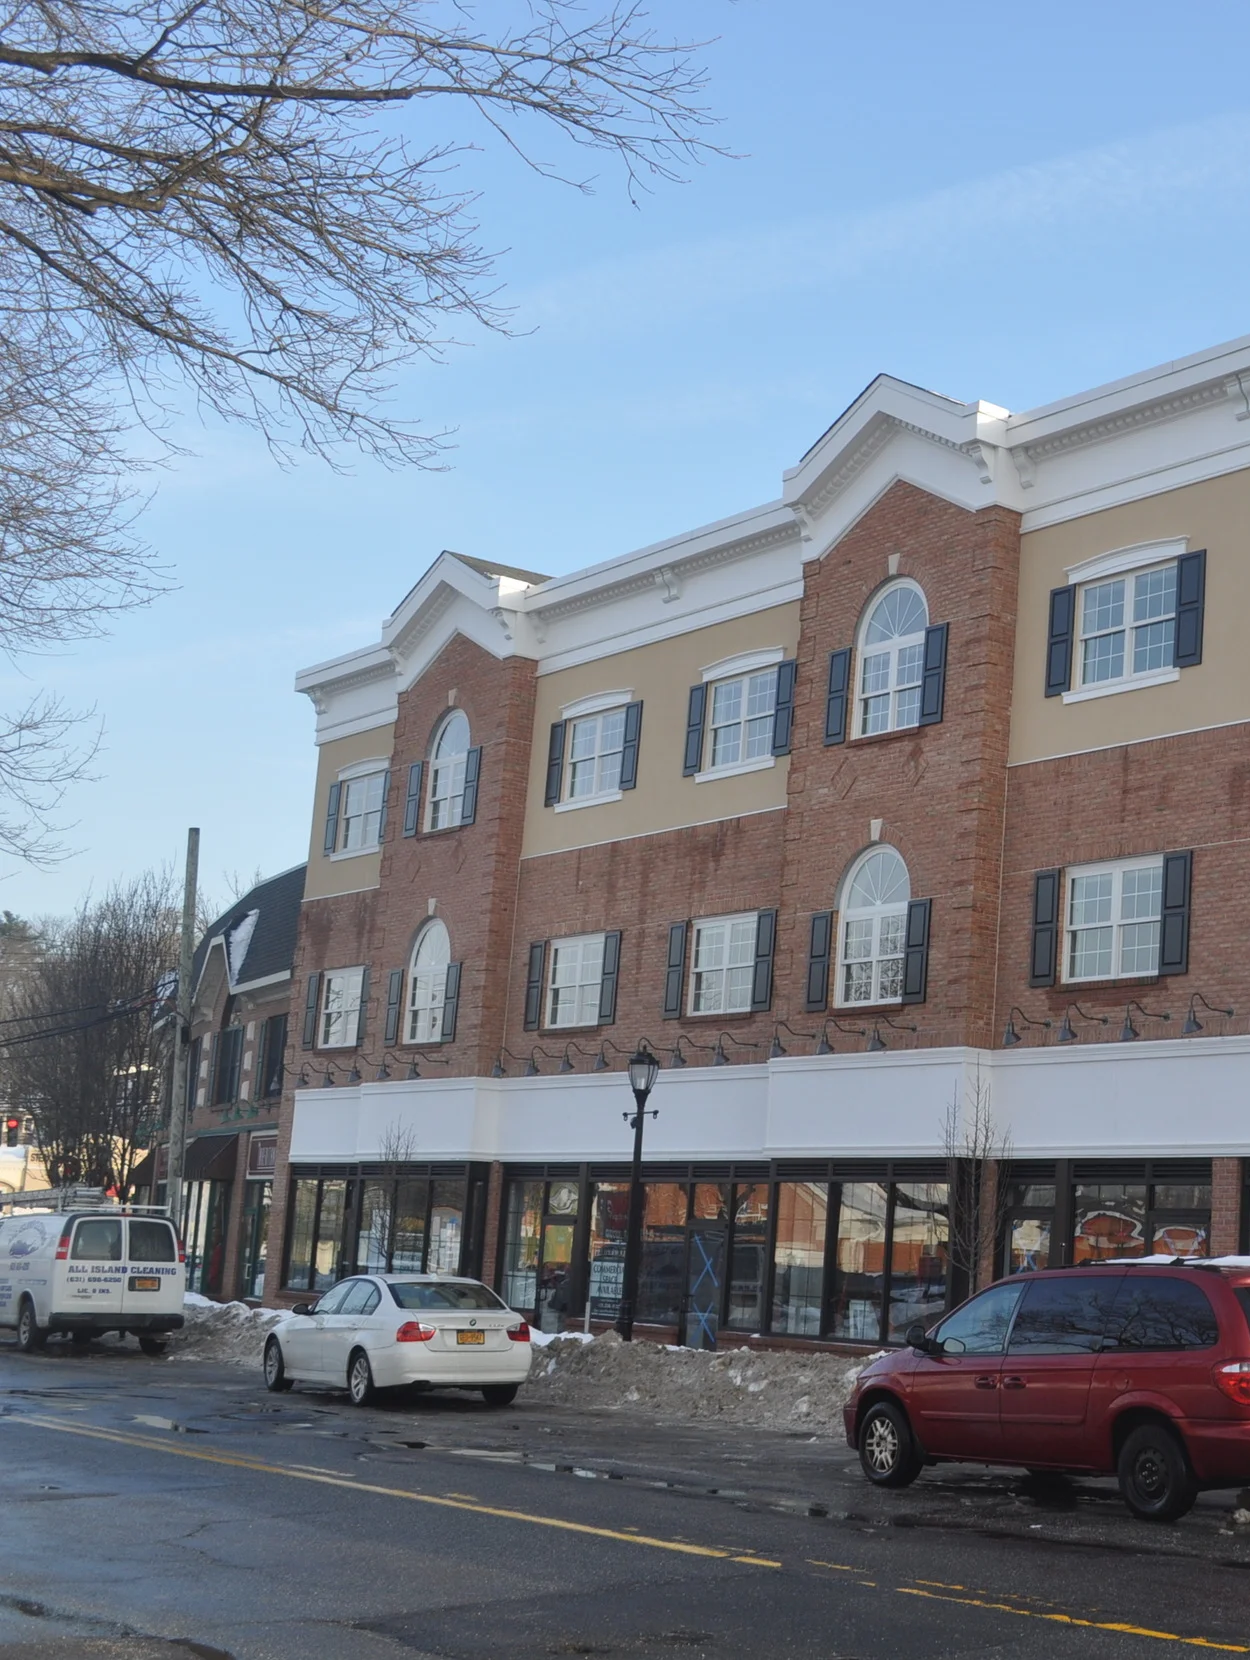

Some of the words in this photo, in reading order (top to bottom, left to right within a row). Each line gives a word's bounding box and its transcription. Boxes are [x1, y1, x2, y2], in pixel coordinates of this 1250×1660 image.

[68, 1265, 88, 1274] ALL
[91, 1265, 127, 1274] ISLAND
[130, 1266, 177, 1275] CLEANING
